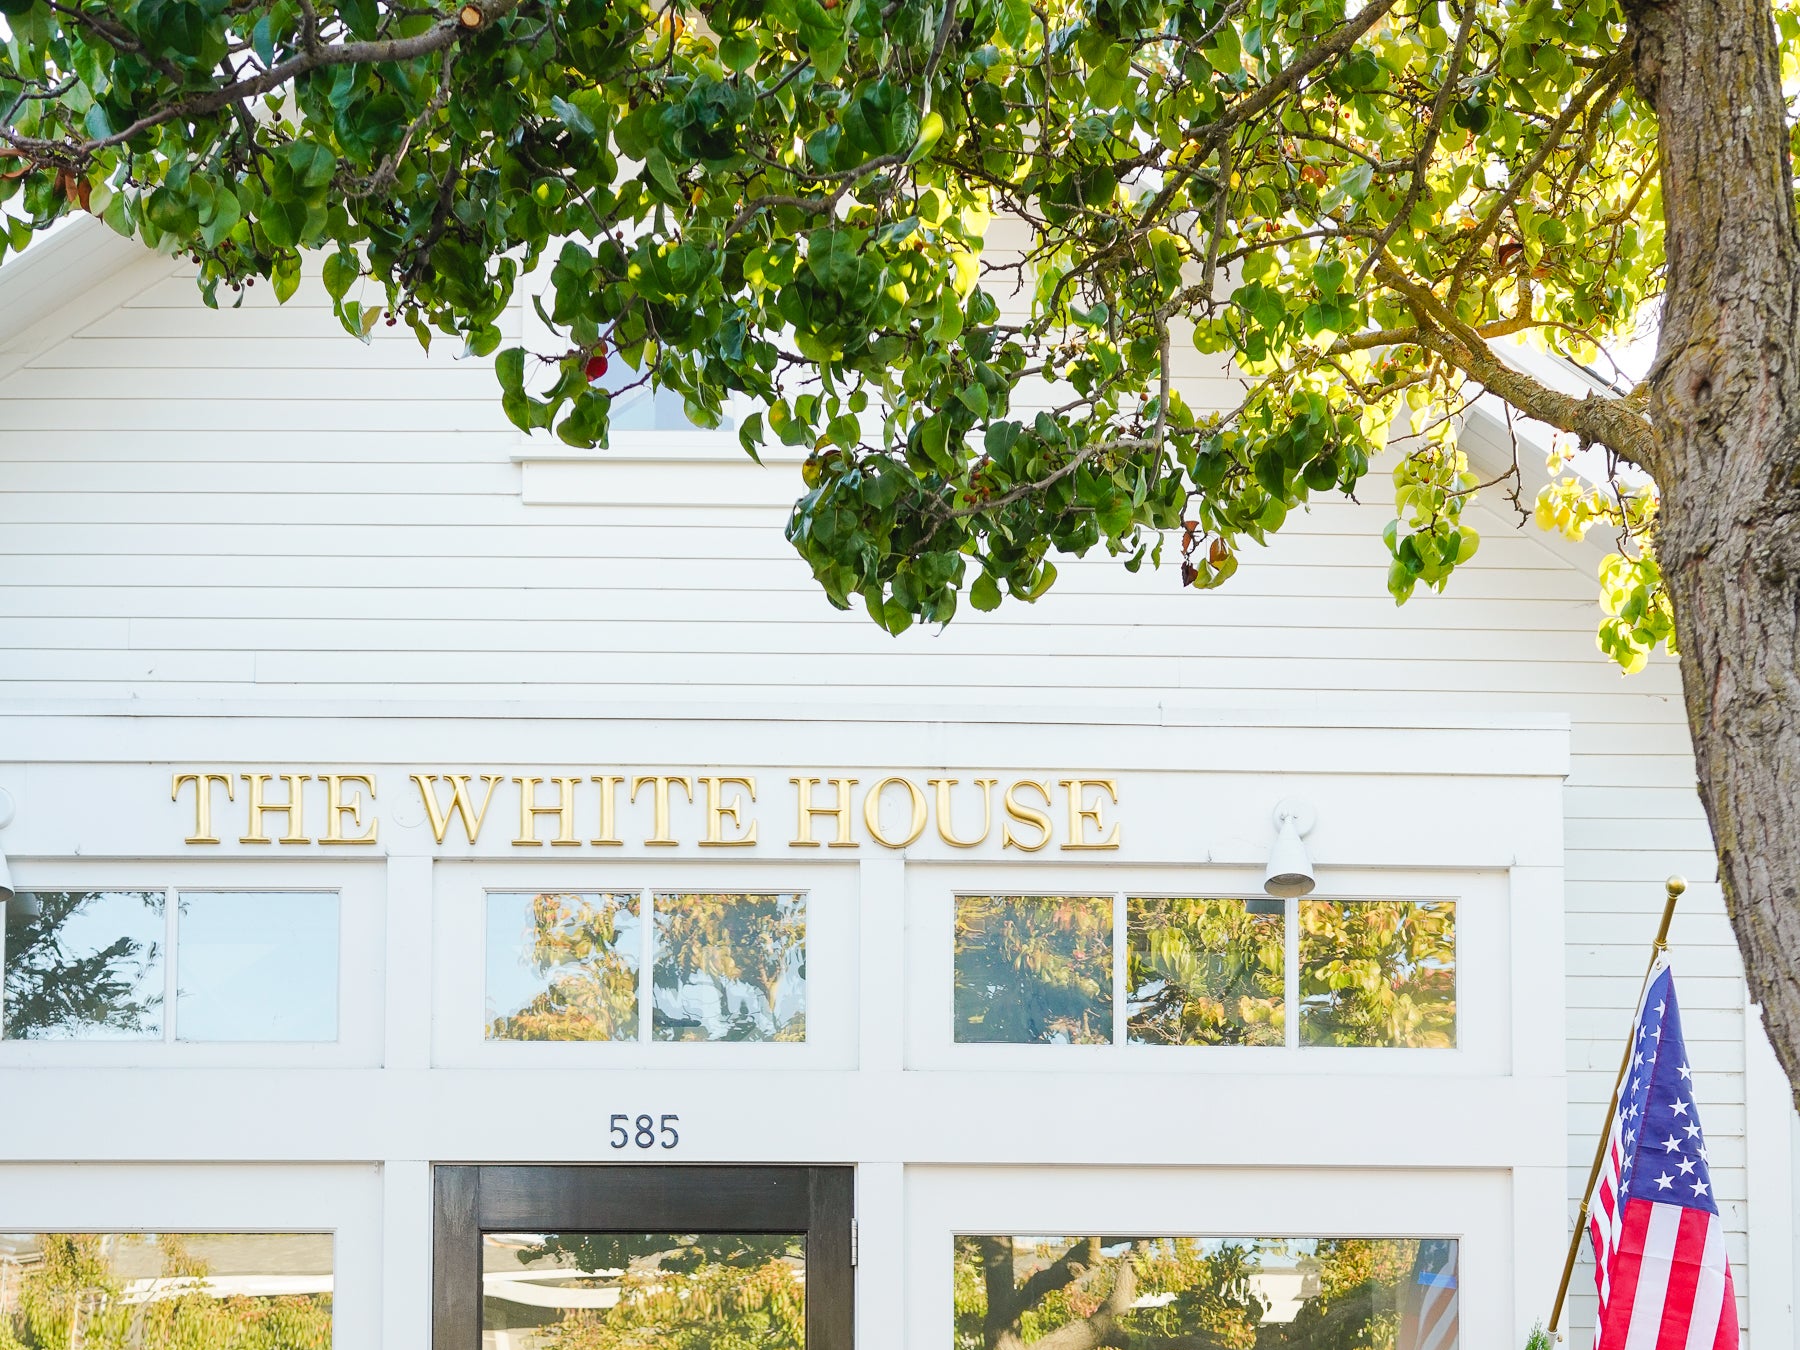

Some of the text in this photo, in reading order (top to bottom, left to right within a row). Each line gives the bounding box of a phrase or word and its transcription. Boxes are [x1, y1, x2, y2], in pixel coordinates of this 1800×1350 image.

[171, 773, 1121, 852] THE WHITE HOUSE
[610, 1114, 680, 1149] 585
